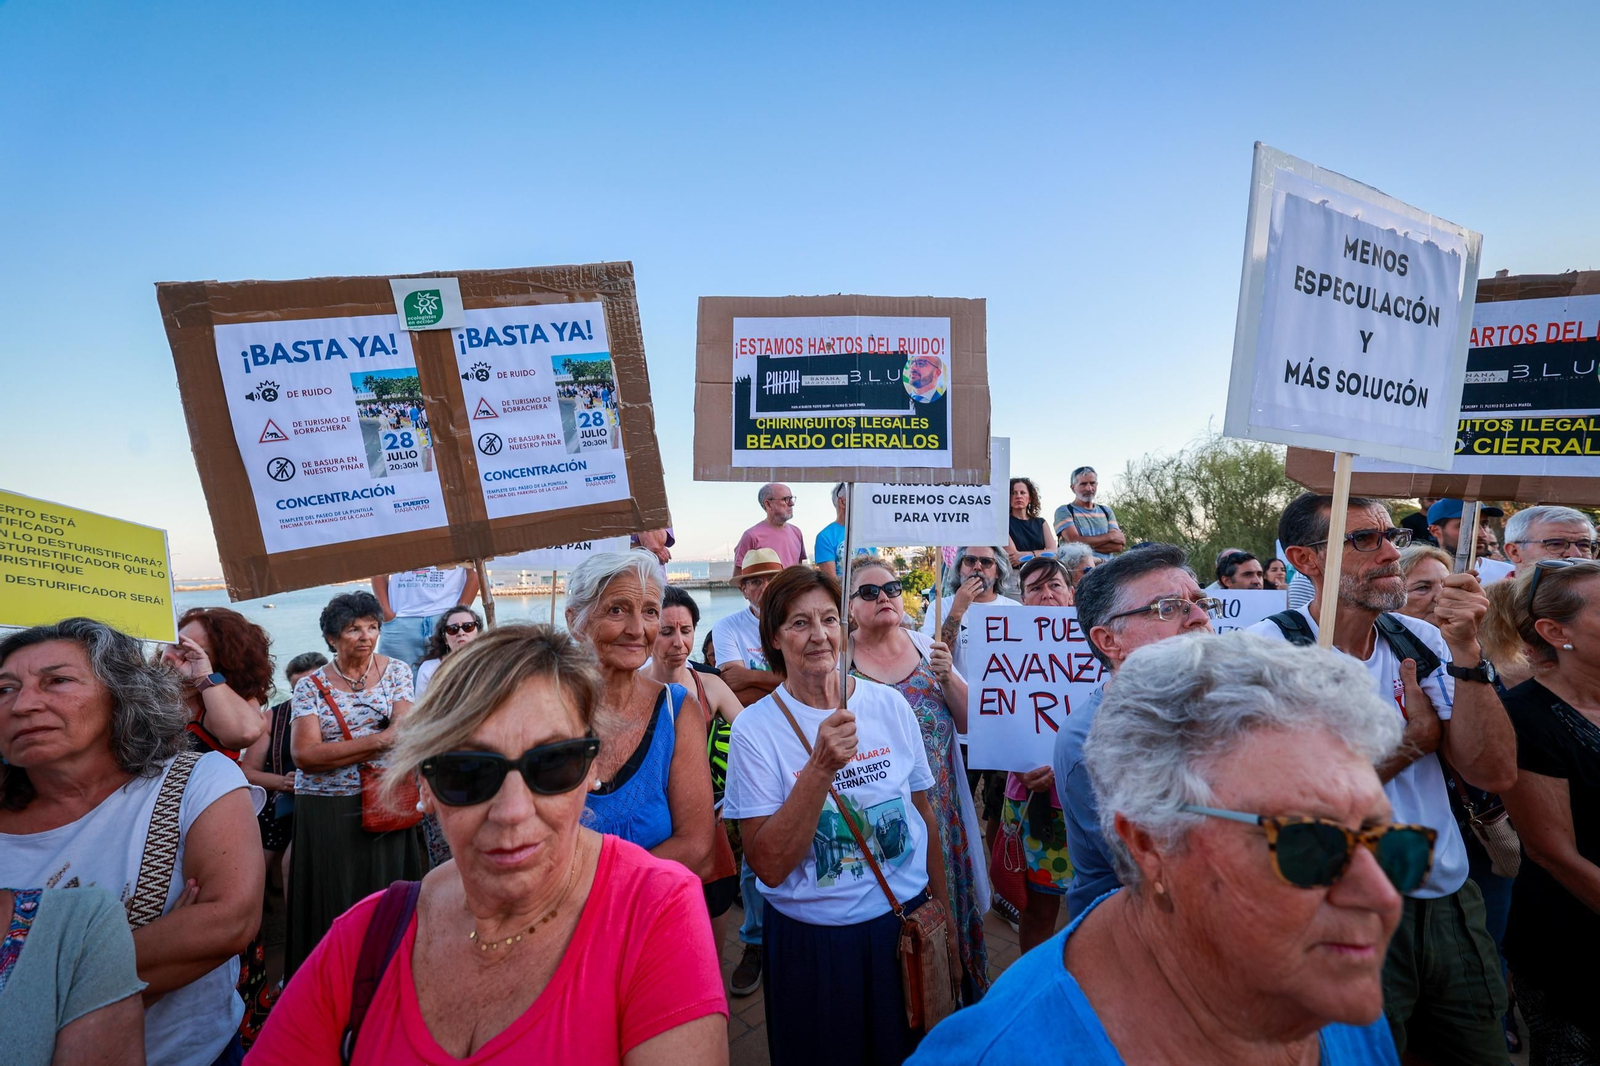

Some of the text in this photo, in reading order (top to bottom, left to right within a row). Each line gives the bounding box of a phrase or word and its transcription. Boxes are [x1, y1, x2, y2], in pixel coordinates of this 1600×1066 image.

[1343, 234, 1409, 277] MENOS
[1294, 266, 1440, 328] ESPECULACIÓN
[458, 320, 594, 354] ¡BASTA YA!
[1546, 321, 1588, 344] DEL
[735, 336, 944, 358] ¡ESTAMOS HARTOS DEL RUIDO!
[1359, 330, 1373, 354] Y
[241, 333, 398, 374] ¡BASTA YA!
[510, 370, 536, 378] RUIDO
[1284, 357, 1428, 410] MÁS SOLUCIÓN
[286, 388, 332, 398] DE RUIDO
[503, 404, 548, 414] BORRACHERA
[512, 398, 540, 406] TURISMO
[305, 418, 339, 426] TURISMO
[578, 412, 604, 428] 28
[756, 416, 929, 430] CHIRINGUITOS ILEGALES
[294, 424, 346, 436] BORRACHERA
[580, 428, 607, 438] JULIO
[384, 432, 414, 450] 28
[509, 442, 539, 450] NUESTRO
[582, 440, 608, 448] 20:30H
[746, 434, 940, 449] BEARDO CIERRALOS
[314, 458, 344, 467] BASURA
[386, 450, 418, 462] JULIO
[304, 463, 364, 476] NUESTRO PINAR
[389, 462, 419, 471] 20:30H
[484, 459, 587, 482] CONCENTRACIÓN
[276, 484, 396, 510] CONCENTRACIÓN
[402, 499, 430, 508] PUERTO
[872, 494, 992, 505] QUEREMOS CASAS
[40, 512, 76, 528] ESTÁ
[315, 517, 338, 525] PARKING
[894, 512, 970, 522] PARA VIVIR
[13, 532, 33, 542] LO
[38, 536, 162, 568] DESTURISTIFICARÁ?
[567, 542, 592, 550] PAN
[124, 564, 148, 576] QUE
[150, 570, 165, 579] LO
[5, 574, 164, 606] DESTURIFICADOR SERÁ!
[986, 616, 1022, 642] EL
[980, 687, 1016, 716] EN
[849, 747, 891, 762] PULAR 24
[842, 768, 856, 779] UN
[857, 760, 890, 775] PUERTO
[834, 771, 887, 792] TERNATIVO
